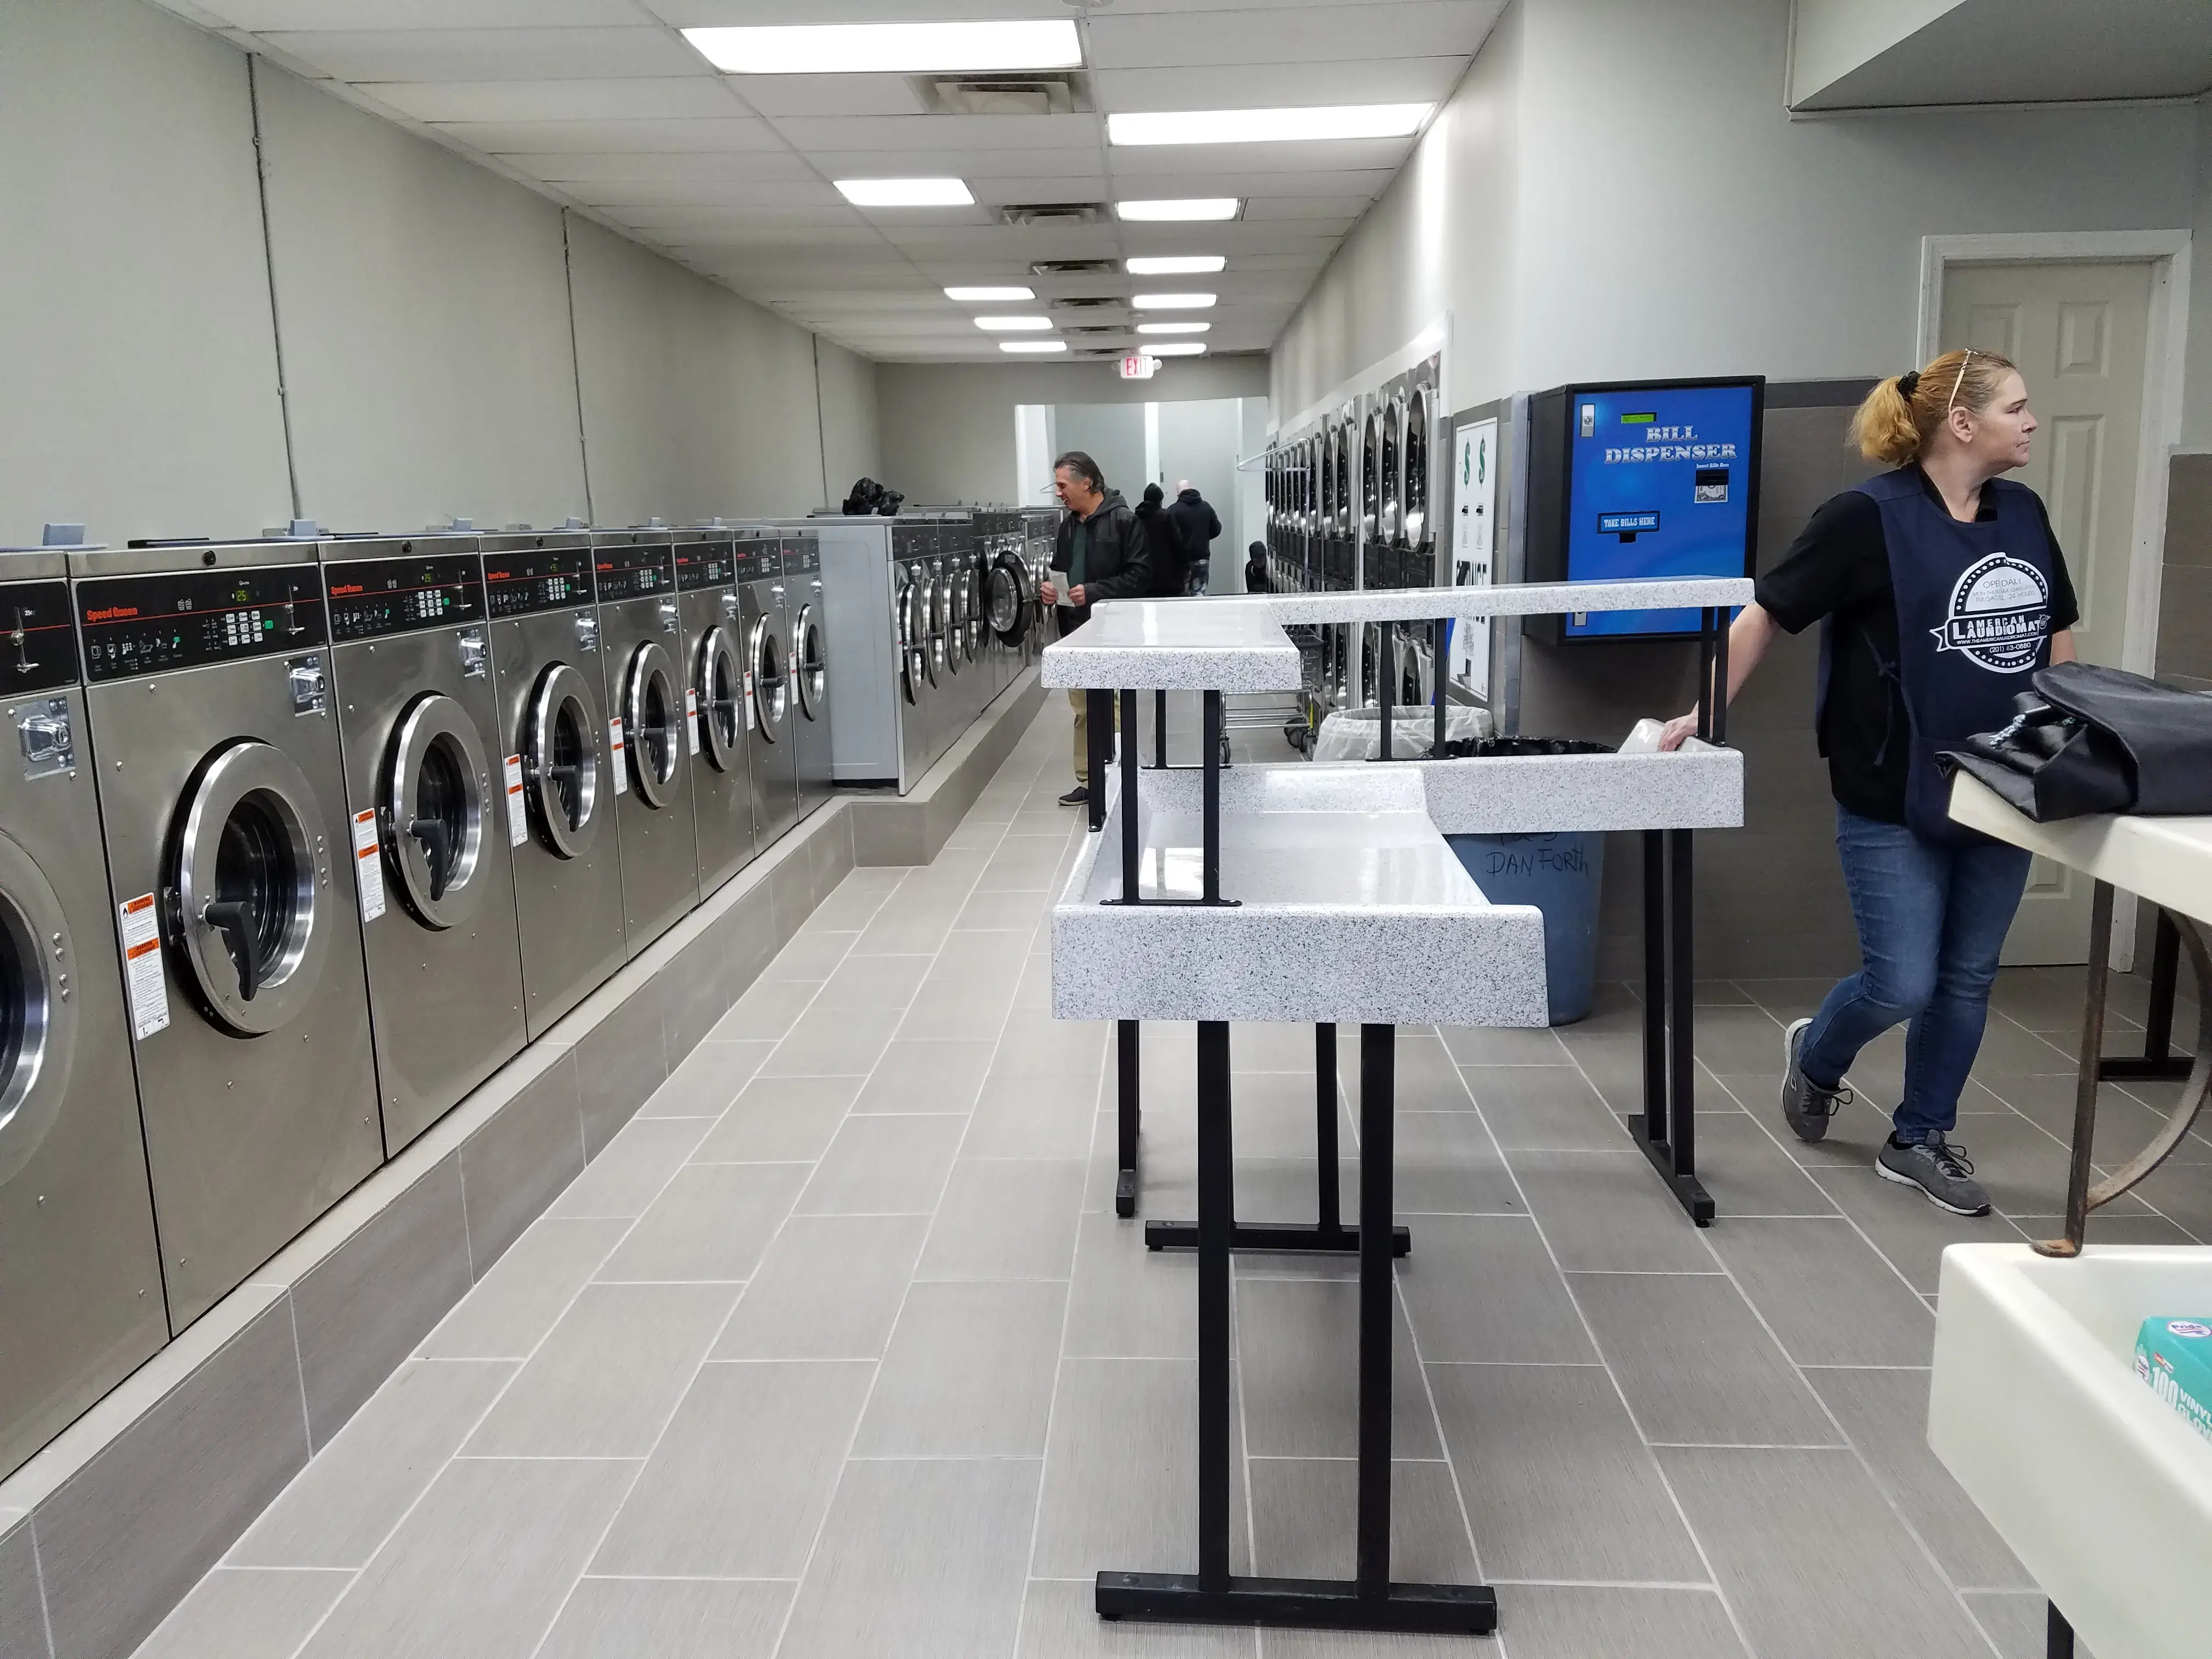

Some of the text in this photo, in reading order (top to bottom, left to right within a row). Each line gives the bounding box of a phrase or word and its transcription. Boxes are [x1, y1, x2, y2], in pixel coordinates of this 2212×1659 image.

[1126, 357, 1147, 376] EXIT
[1646, 425, 1698, 442] BILL
[1605, 443, 1737, 464] DISPENSER
[1604, 516, 1655, 528] TAKE BILLS HERE
[1983, 578, 2021, 588] OPE DAILY
[87, 607, 138, 622] Speed Queen
[2153, 1367, 2179, 1408] 100
[2180, 1388, 2212, 1427] VINYL
